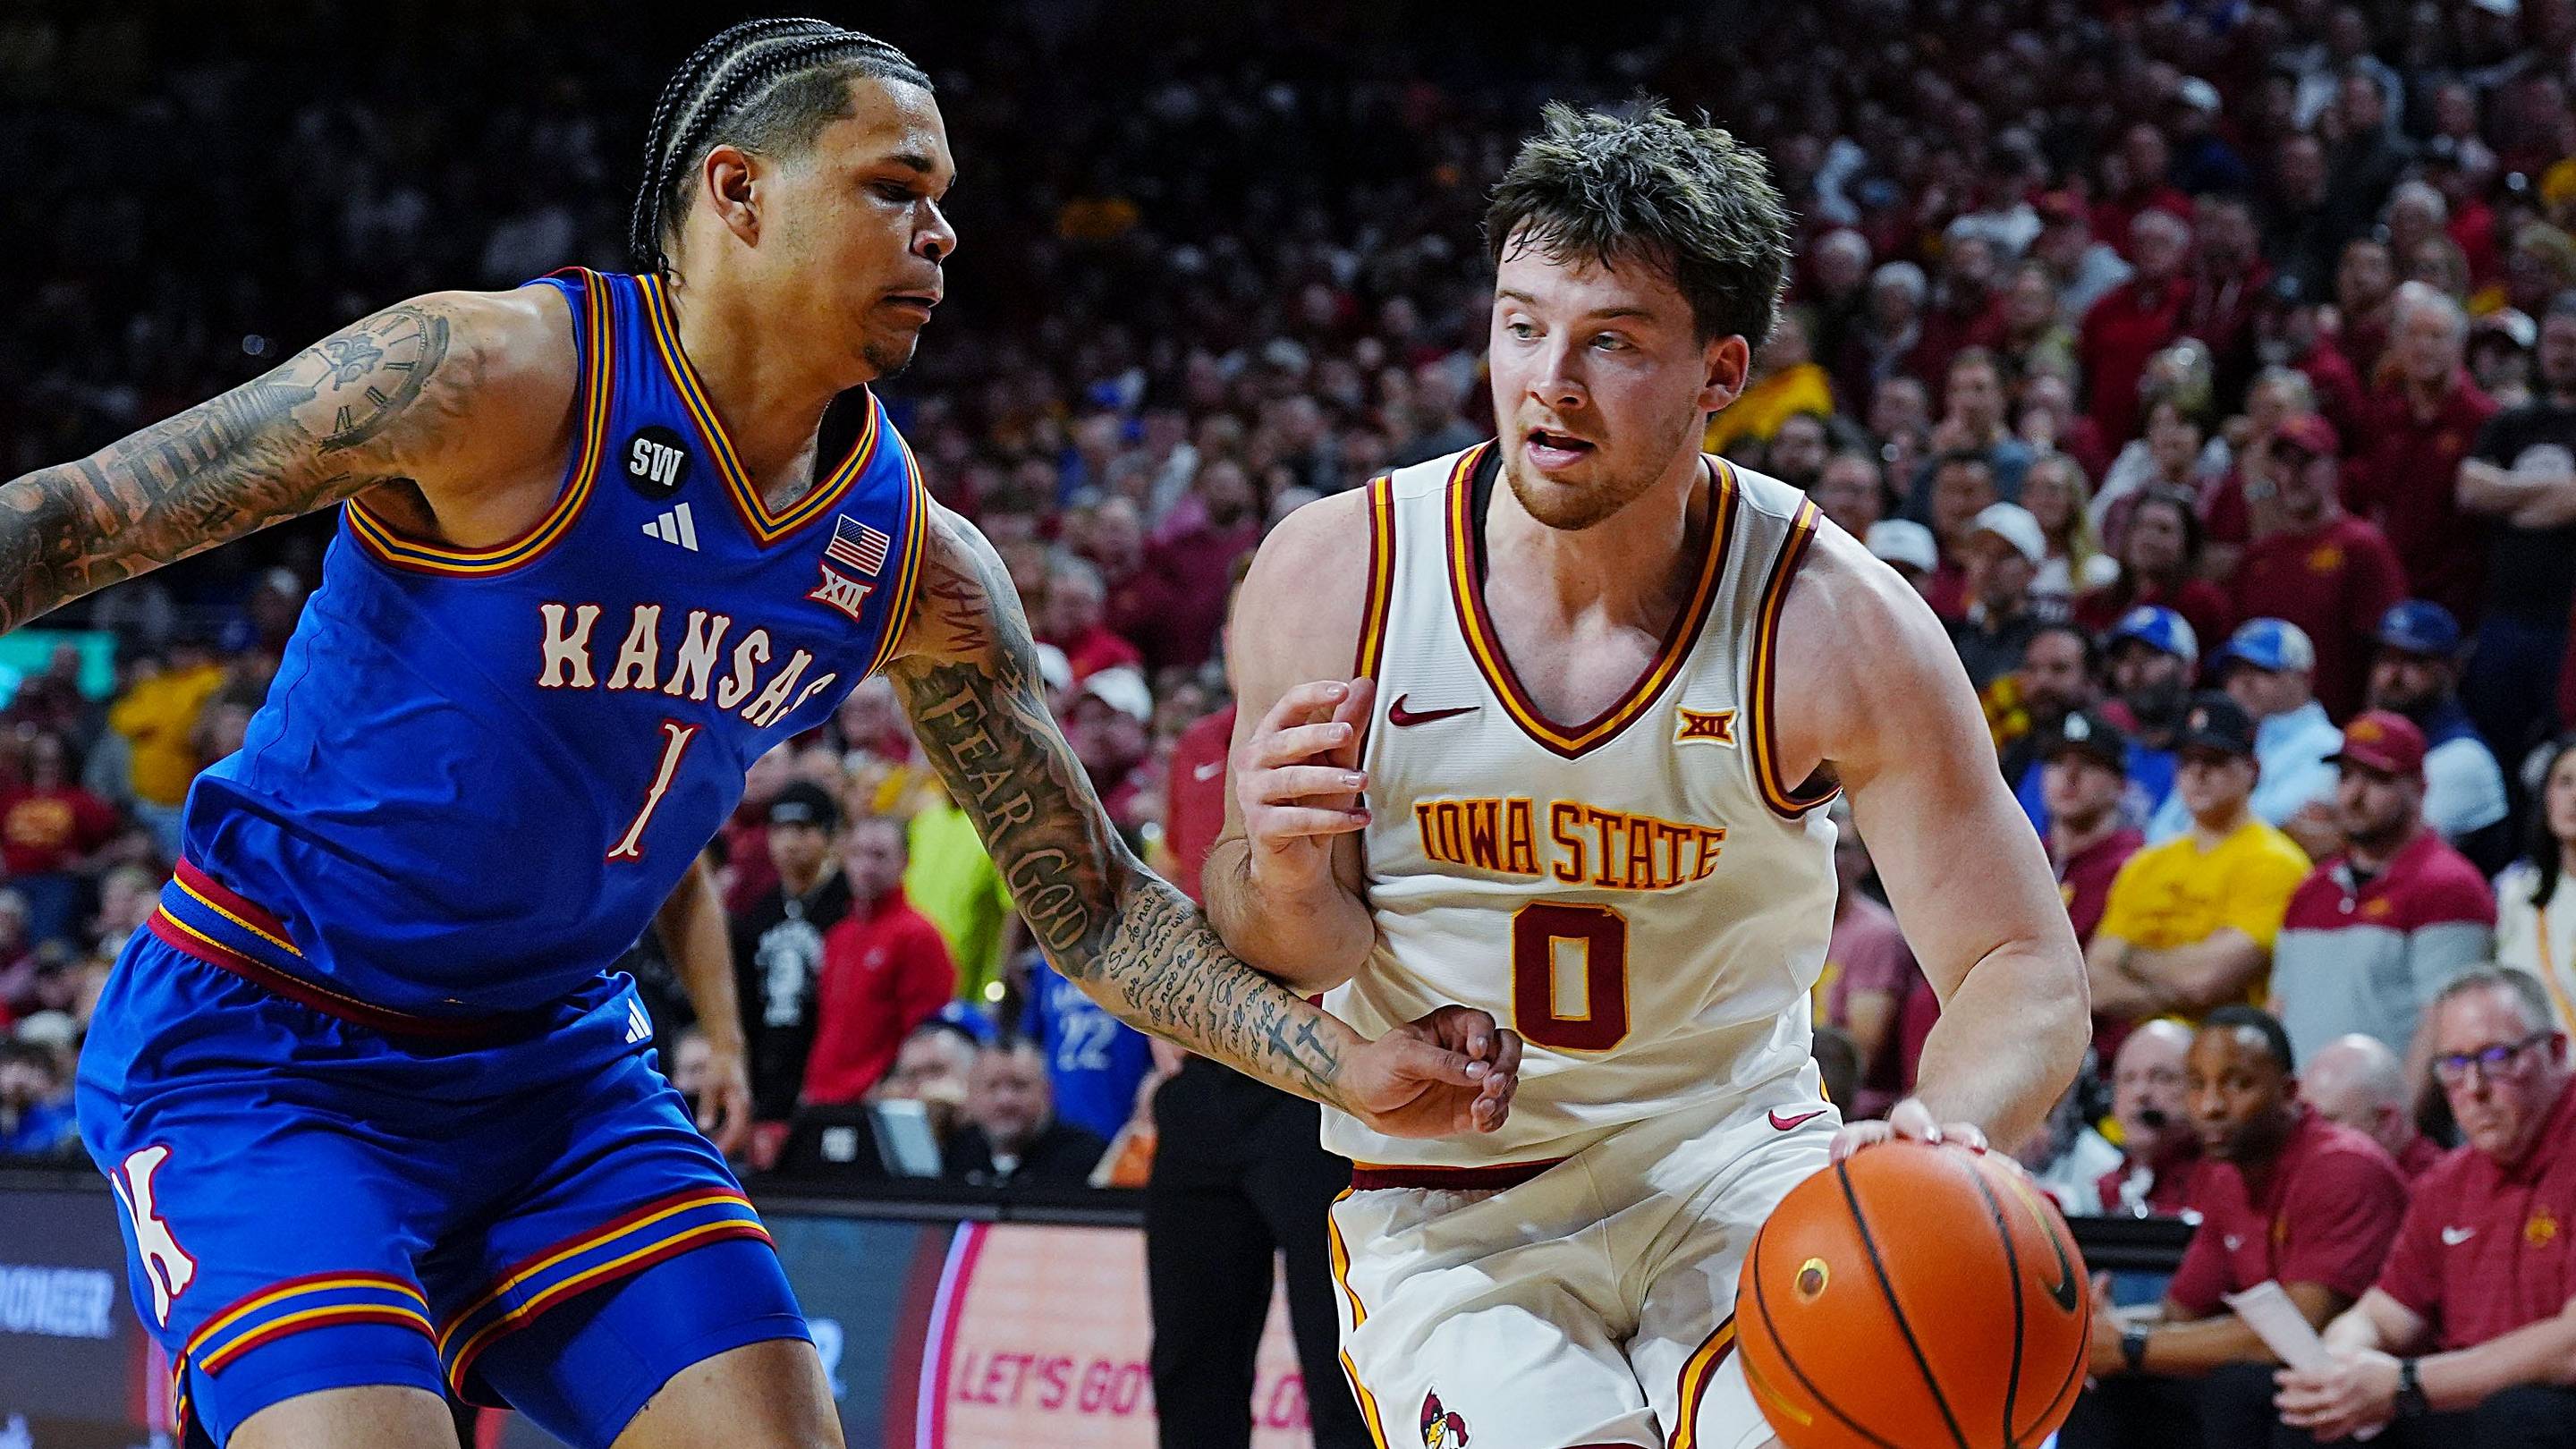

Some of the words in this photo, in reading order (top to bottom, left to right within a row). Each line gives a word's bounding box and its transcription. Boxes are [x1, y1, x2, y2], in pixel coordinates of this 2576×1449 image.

[630, 437, 684, 487] SW
[809, 564, 872, 619] XII
[1679, 708, 1736, 743] XII
[607, 722, 694, 859] 1
[922, 679, 1035, 849] FEAR
[1007, 847, 1089, 952] GOD
[1414, 797, 1542, 877] IOWA
[1550, 800, 1727, 891] STATE
[1108, 945, 1129, 971] So
[1125, 923, 1140, 944] do
[1137, 896, 1156, 922] not
[1122, 976, 1140, 1009] for
[1138, 954, 1152, 973] I
[1193, 971, 1206, 993] I
[1511, 900, 1631, 1053] 0
